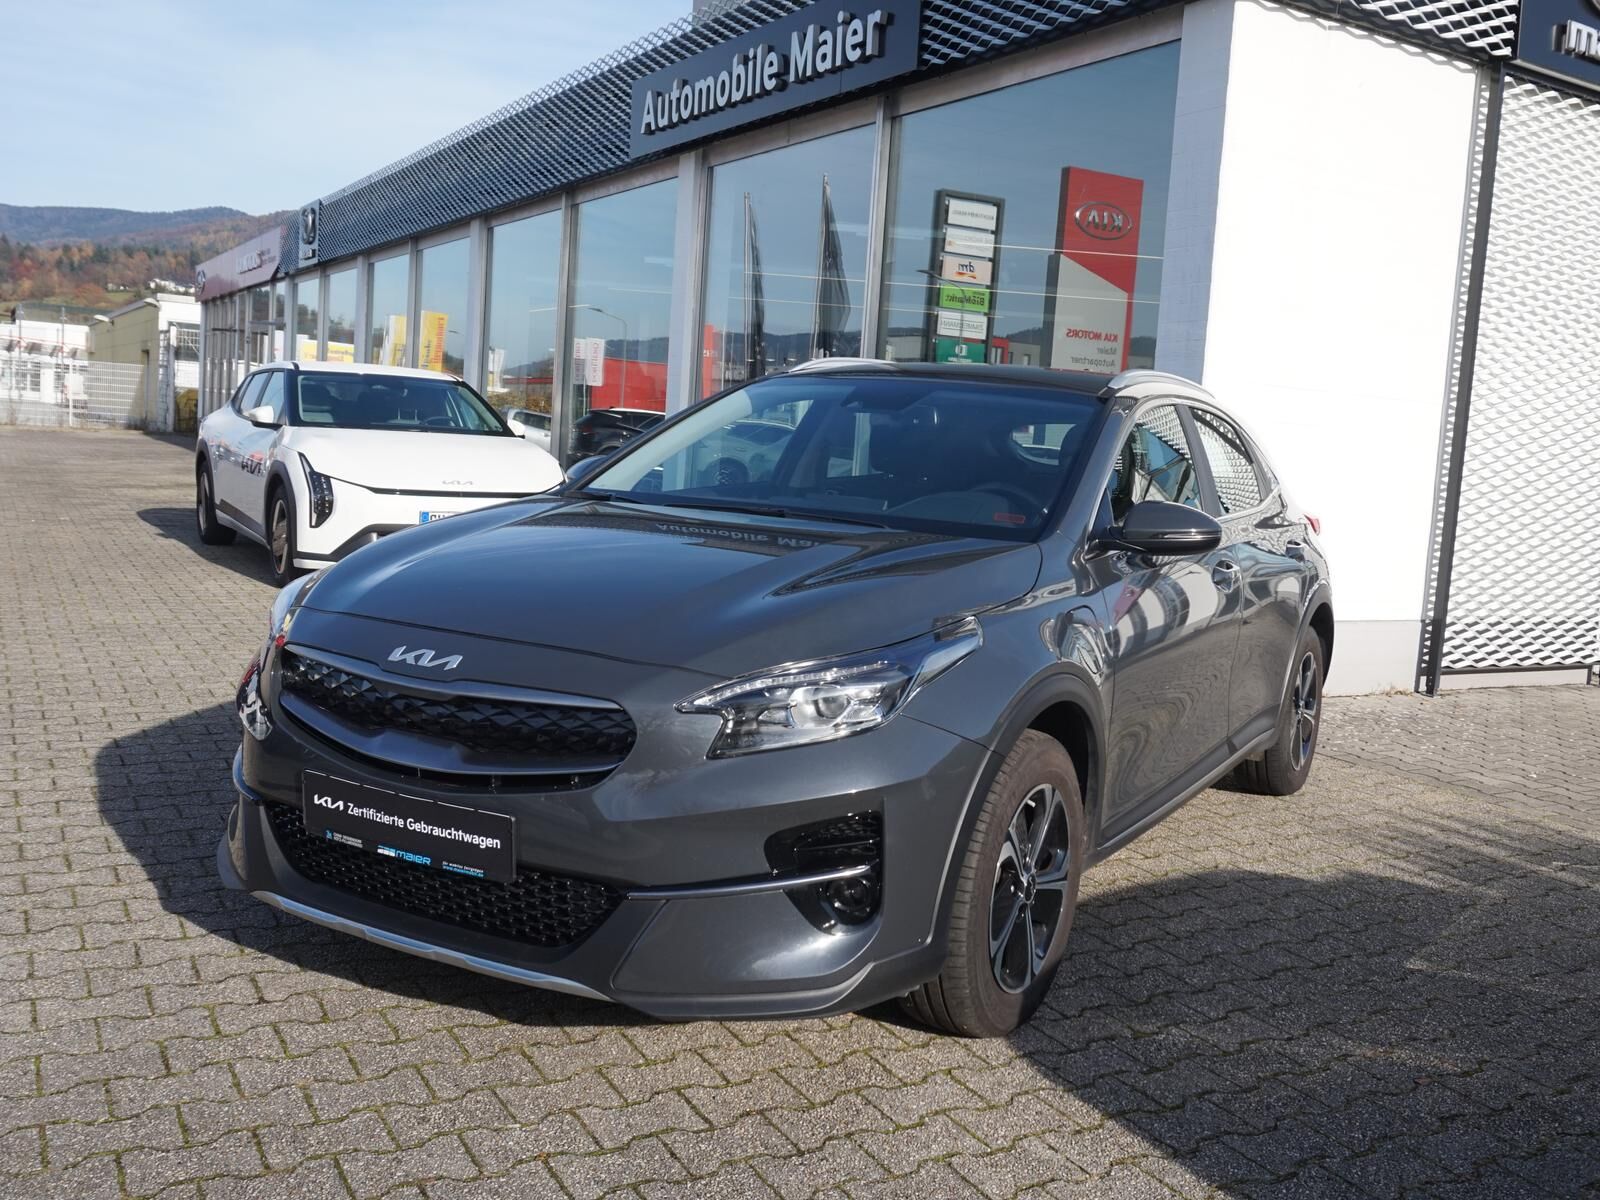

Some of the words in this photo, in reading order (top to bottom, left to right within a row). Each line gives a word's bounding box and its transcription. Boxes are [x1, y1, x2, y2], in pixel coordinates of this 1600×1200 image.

[640, 43, 780, 134] Automobile
[789, 9, 885, 82] Maier
[387, 645, 463, 671] KIA
[313, 794, 344, 811] KIA
[347, 803, 405, 828] Zertifizierte
[406, 818, 501, 849] Gebrauchtwagen
